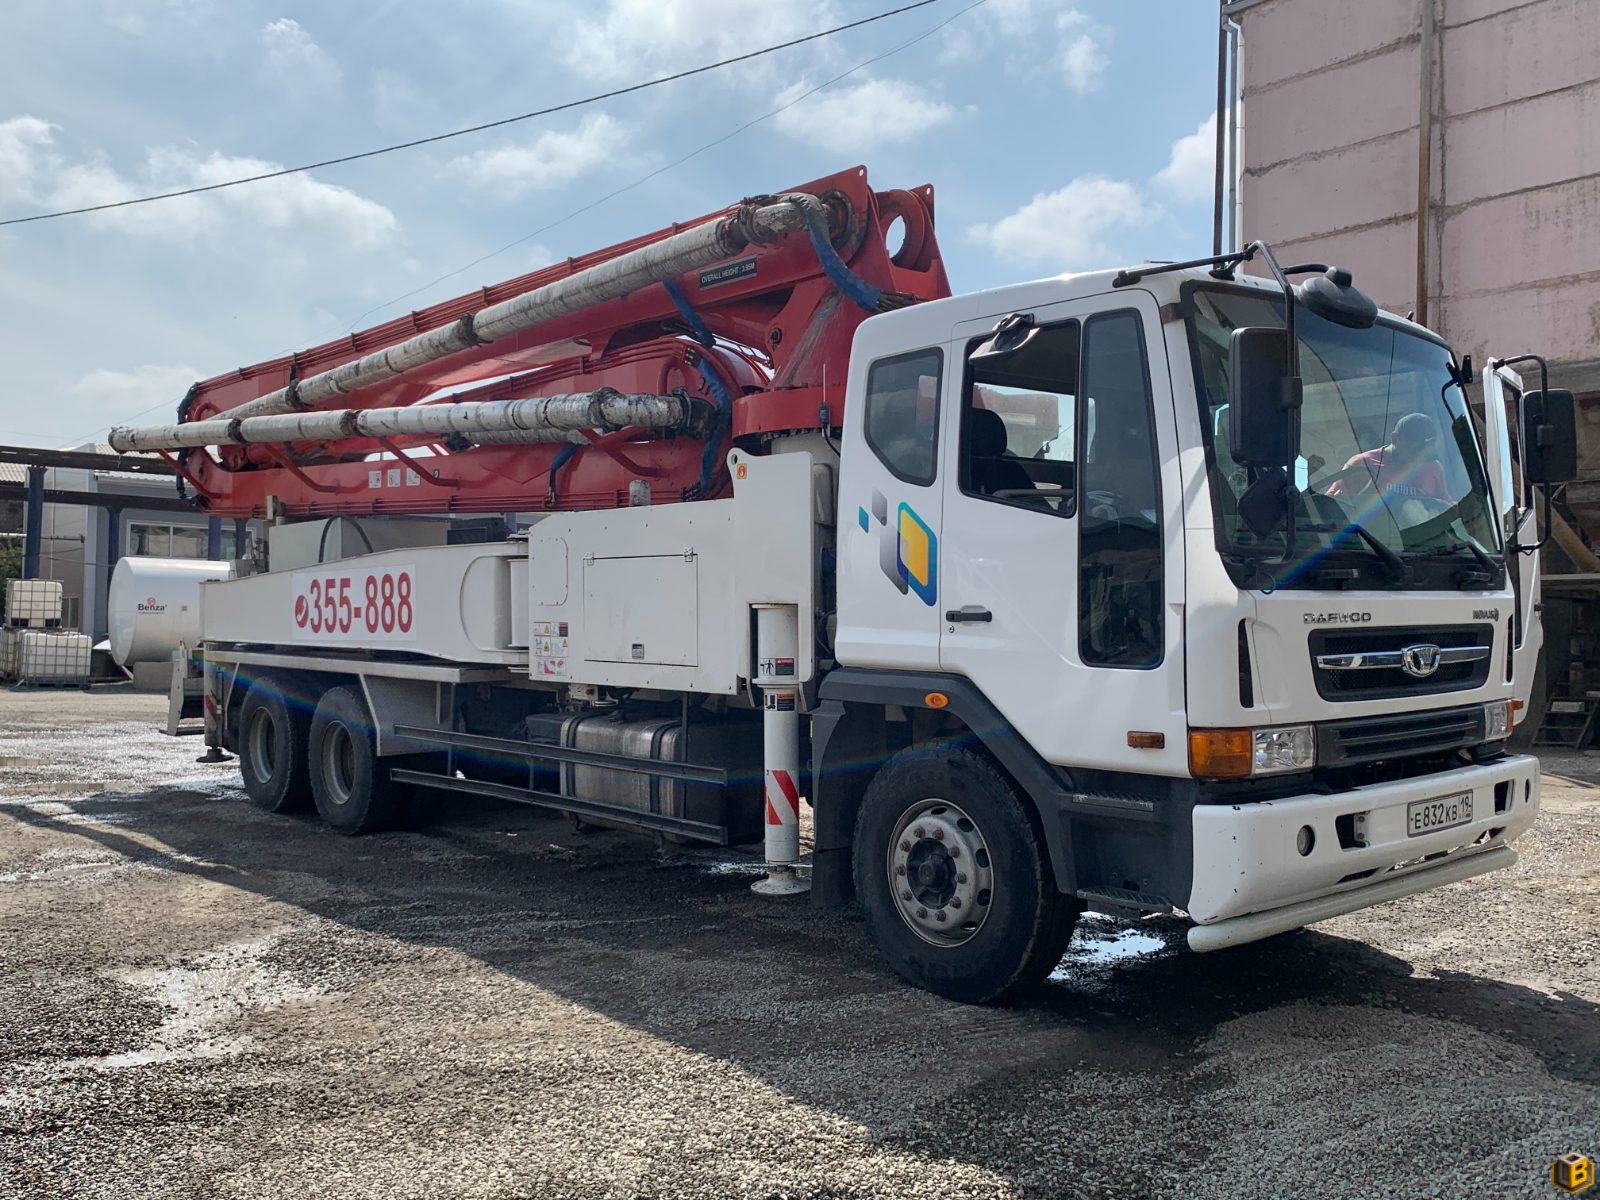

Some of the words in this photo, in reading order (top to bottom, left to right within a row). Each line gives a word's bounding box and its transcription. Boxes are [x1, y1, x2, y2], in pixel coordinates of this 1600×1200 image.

[702, 271, 722, 283] OVERALL
[722, 266, 739, 277] HEIGHT
[137, 603, 165, 611] Benza
[310, 572, 413, 634] 355-888
[1303, 612, 1372, 625] DAEWOO
[1460, 795, 1469, 812] 19
